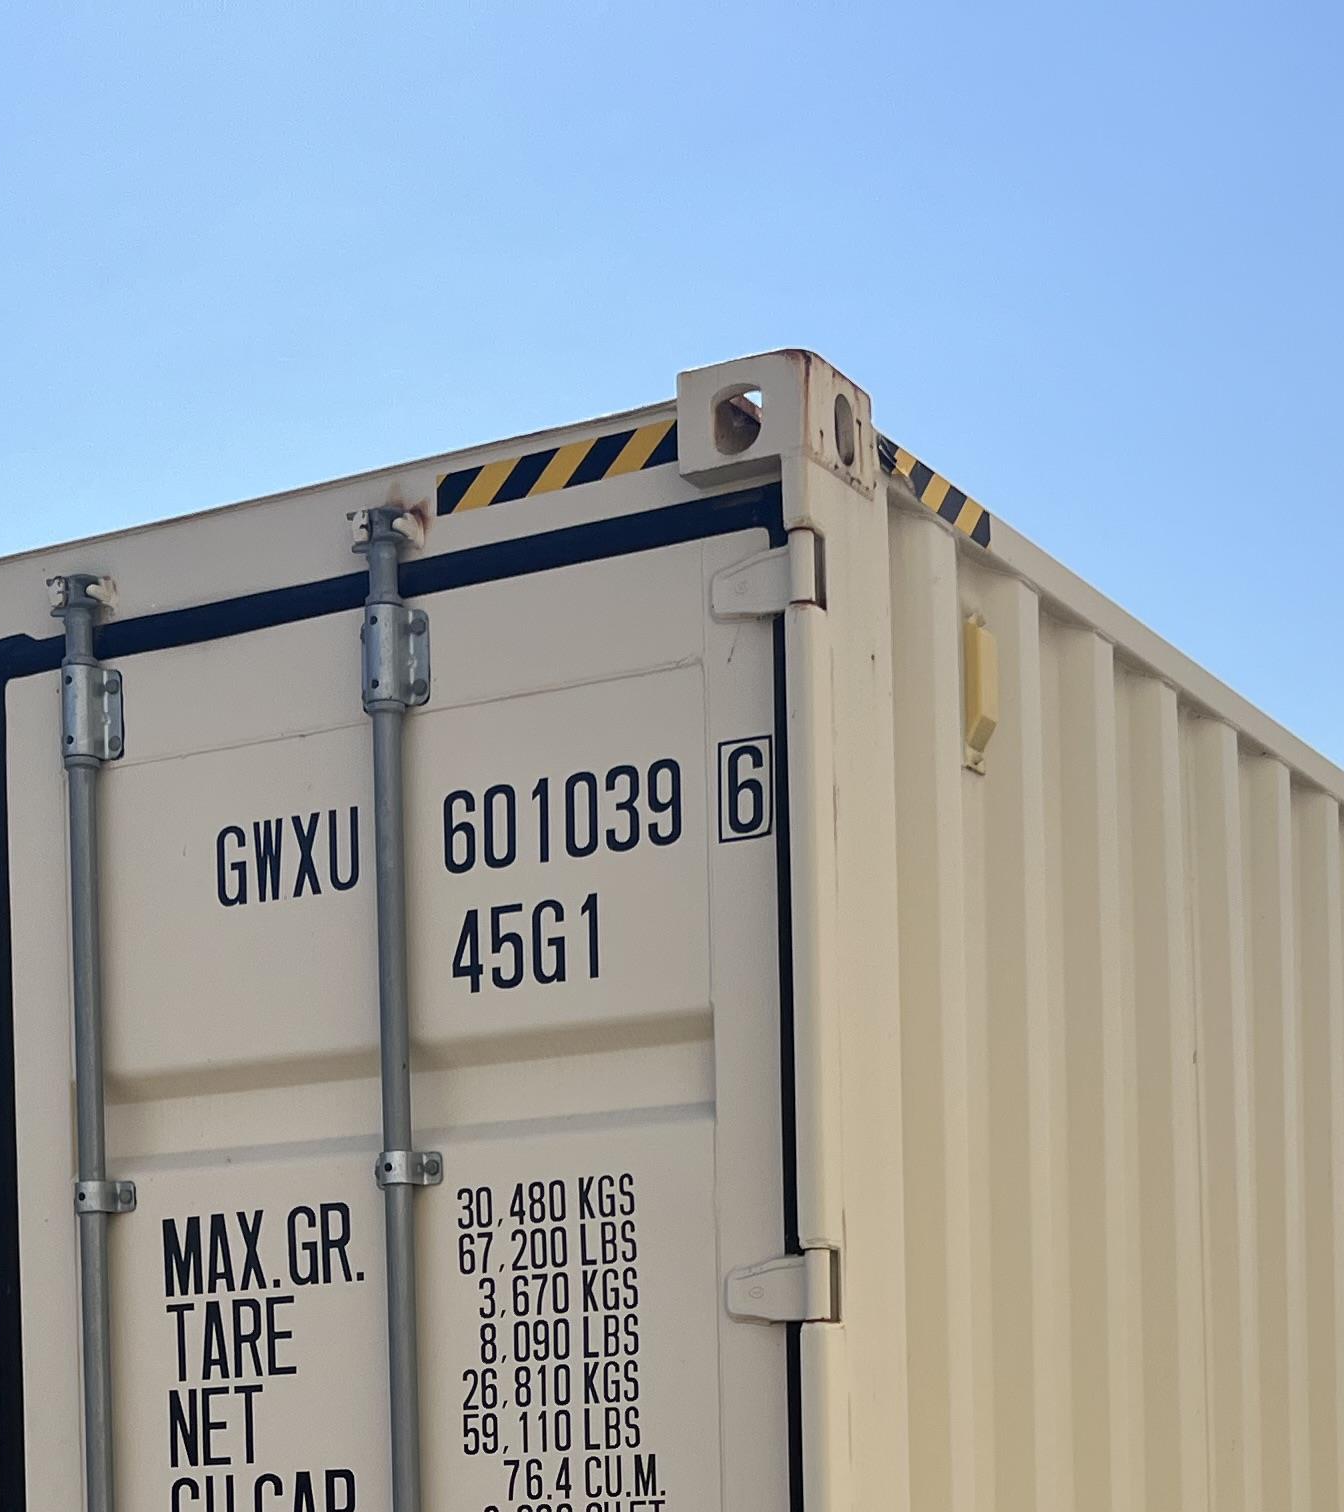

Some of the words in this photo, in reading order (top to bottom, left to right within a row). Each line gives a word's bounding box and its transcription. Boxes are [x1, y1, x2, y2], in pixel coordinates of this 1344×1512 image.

[217, 806, 360, 907] GWXU
[443, 759, 682, 874] 601039
[727, 744, 765, 835] 6
[452, 893, 600, 993] 45G1
[456, 1179, 567, 1229] 30,480
[578, 1173, 636, 1220] KGS
[163, 1203, 365, 1297] MAX.GR.
[458, 1226, 568, 1275] 67,200
[580, 1220, 637, 1266] LBS
[478, 1272, 570, 1319] 3,670
[582, 1267, 639, 1313] KGS
[166, 1296, 297, 1382] TARE
[479, 1318, 571, 1364] 8,090
[583, 1313, 639, 1359] LBS
[462, 1364, 571, 1411] 26,810
[583, 1360, 640, 1404] KGS
[169, 1385, 263, 1467] NET
[463, 1409, 572, 1455] 59,110
[584, 1406, 641, 1451] LBS
[503, 1456, 572, 1501] 76.4
[584, 1453, 666, 1499] CU.M.
